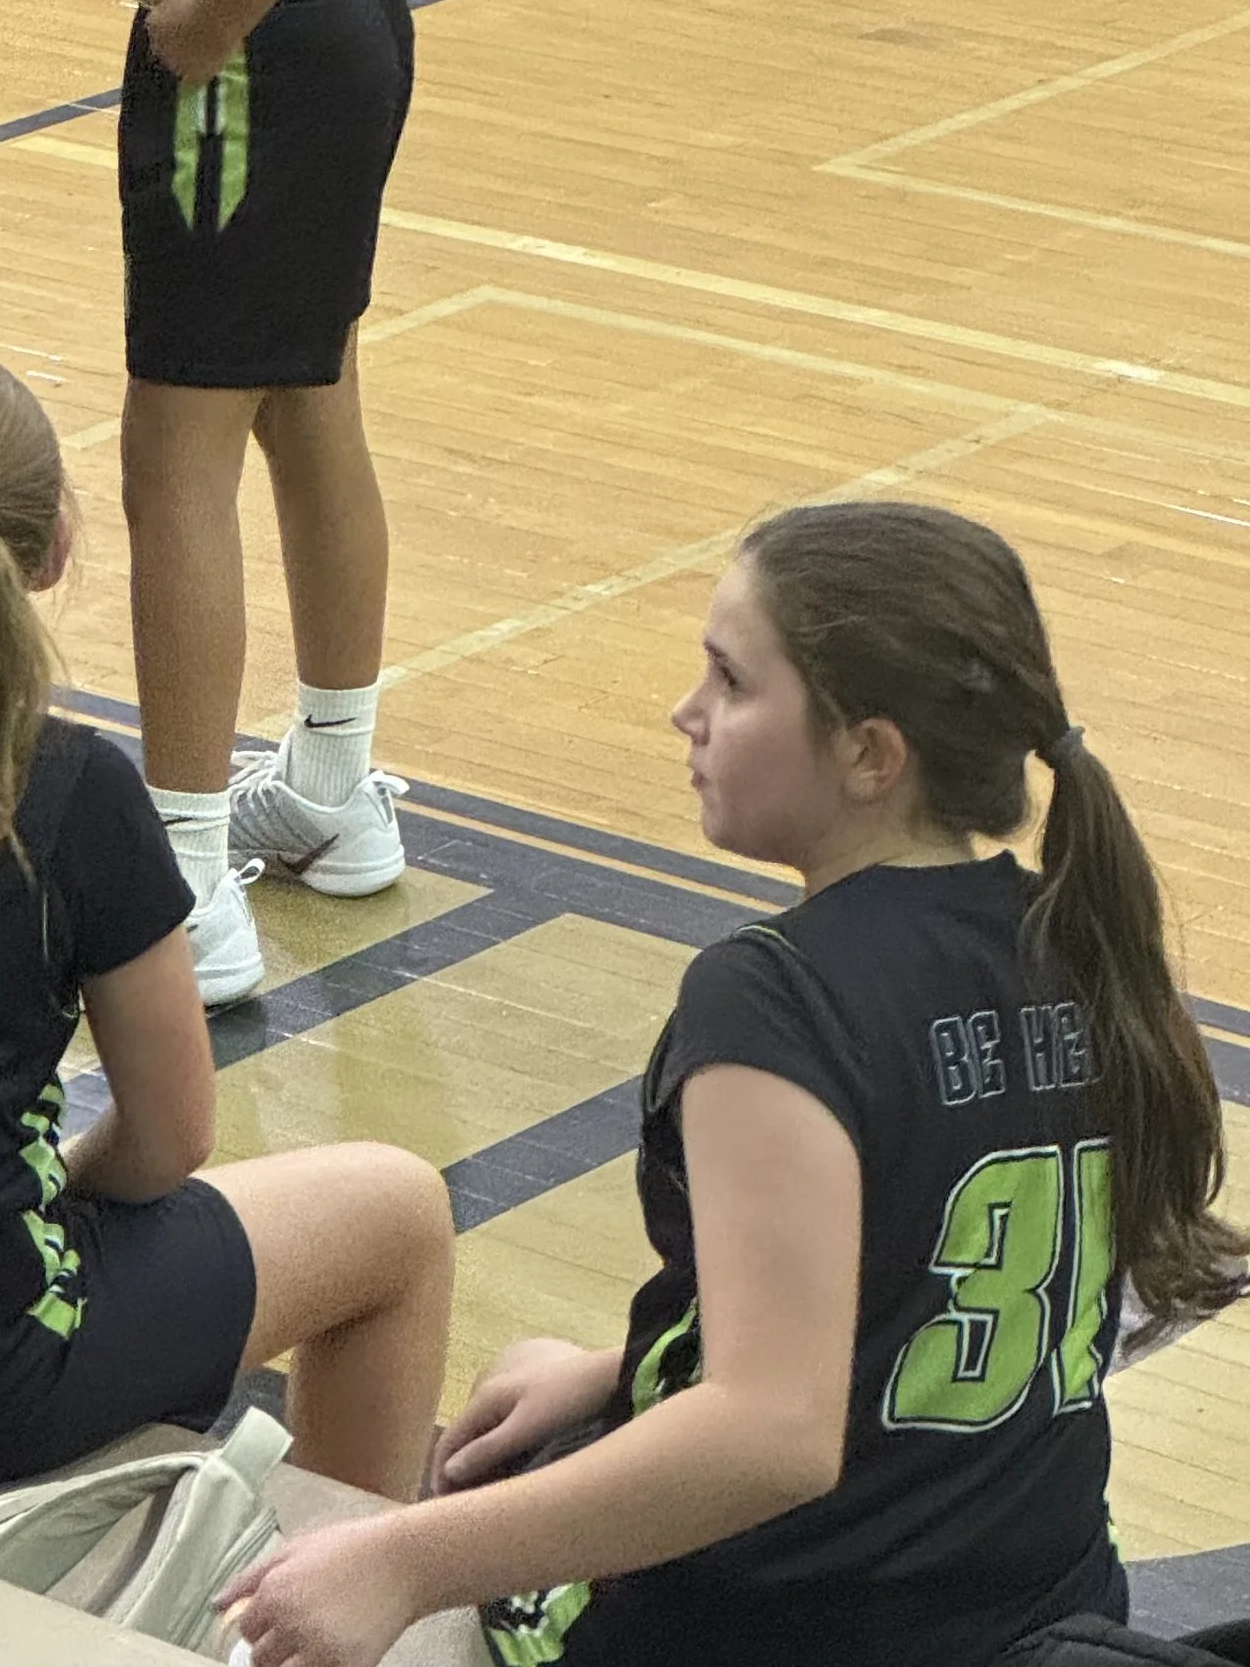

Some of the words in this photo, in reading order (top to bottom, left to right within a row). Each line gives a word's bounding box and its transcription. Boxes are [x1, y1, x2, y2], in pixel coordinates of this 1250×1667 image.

[929, 1009, 1007, 1106] BE
[1019, 1001, 1102, 1092] HE
[879, 1137, 1117, 1433] 31
